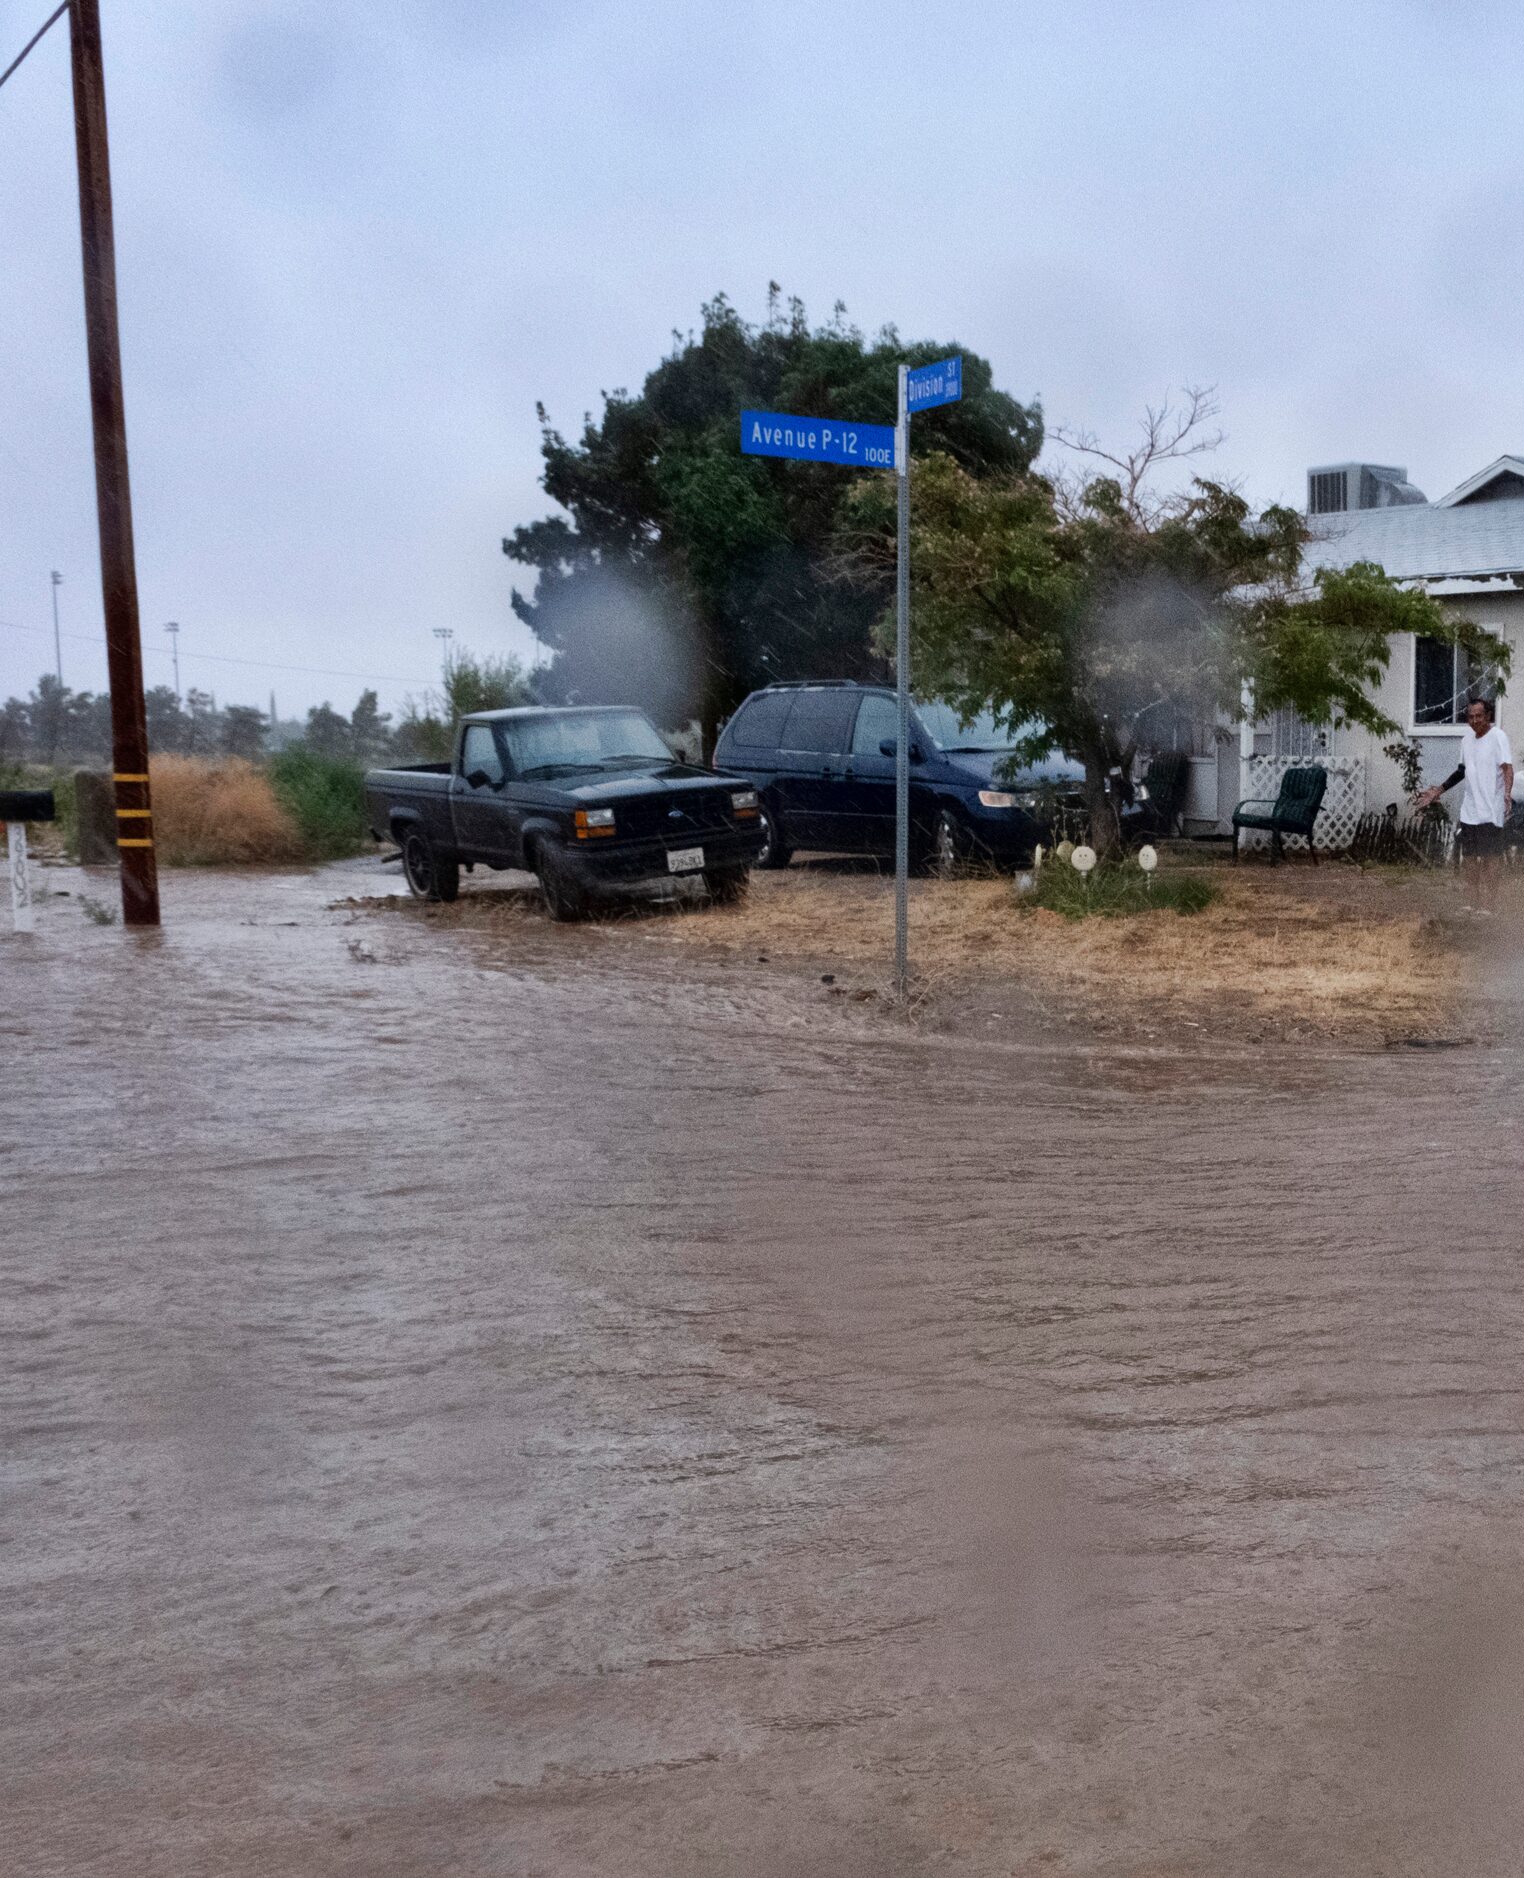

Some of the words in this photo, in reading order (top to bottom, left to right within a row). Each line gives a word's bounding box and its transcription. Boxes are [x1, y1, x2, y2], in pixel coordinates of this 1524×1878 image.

[909, 376, 944, 402] Division
[751, 421, 817, 449] Avenue
[822, 429, 858, 454] P-12
[865, 447, 892, 464] 100E
